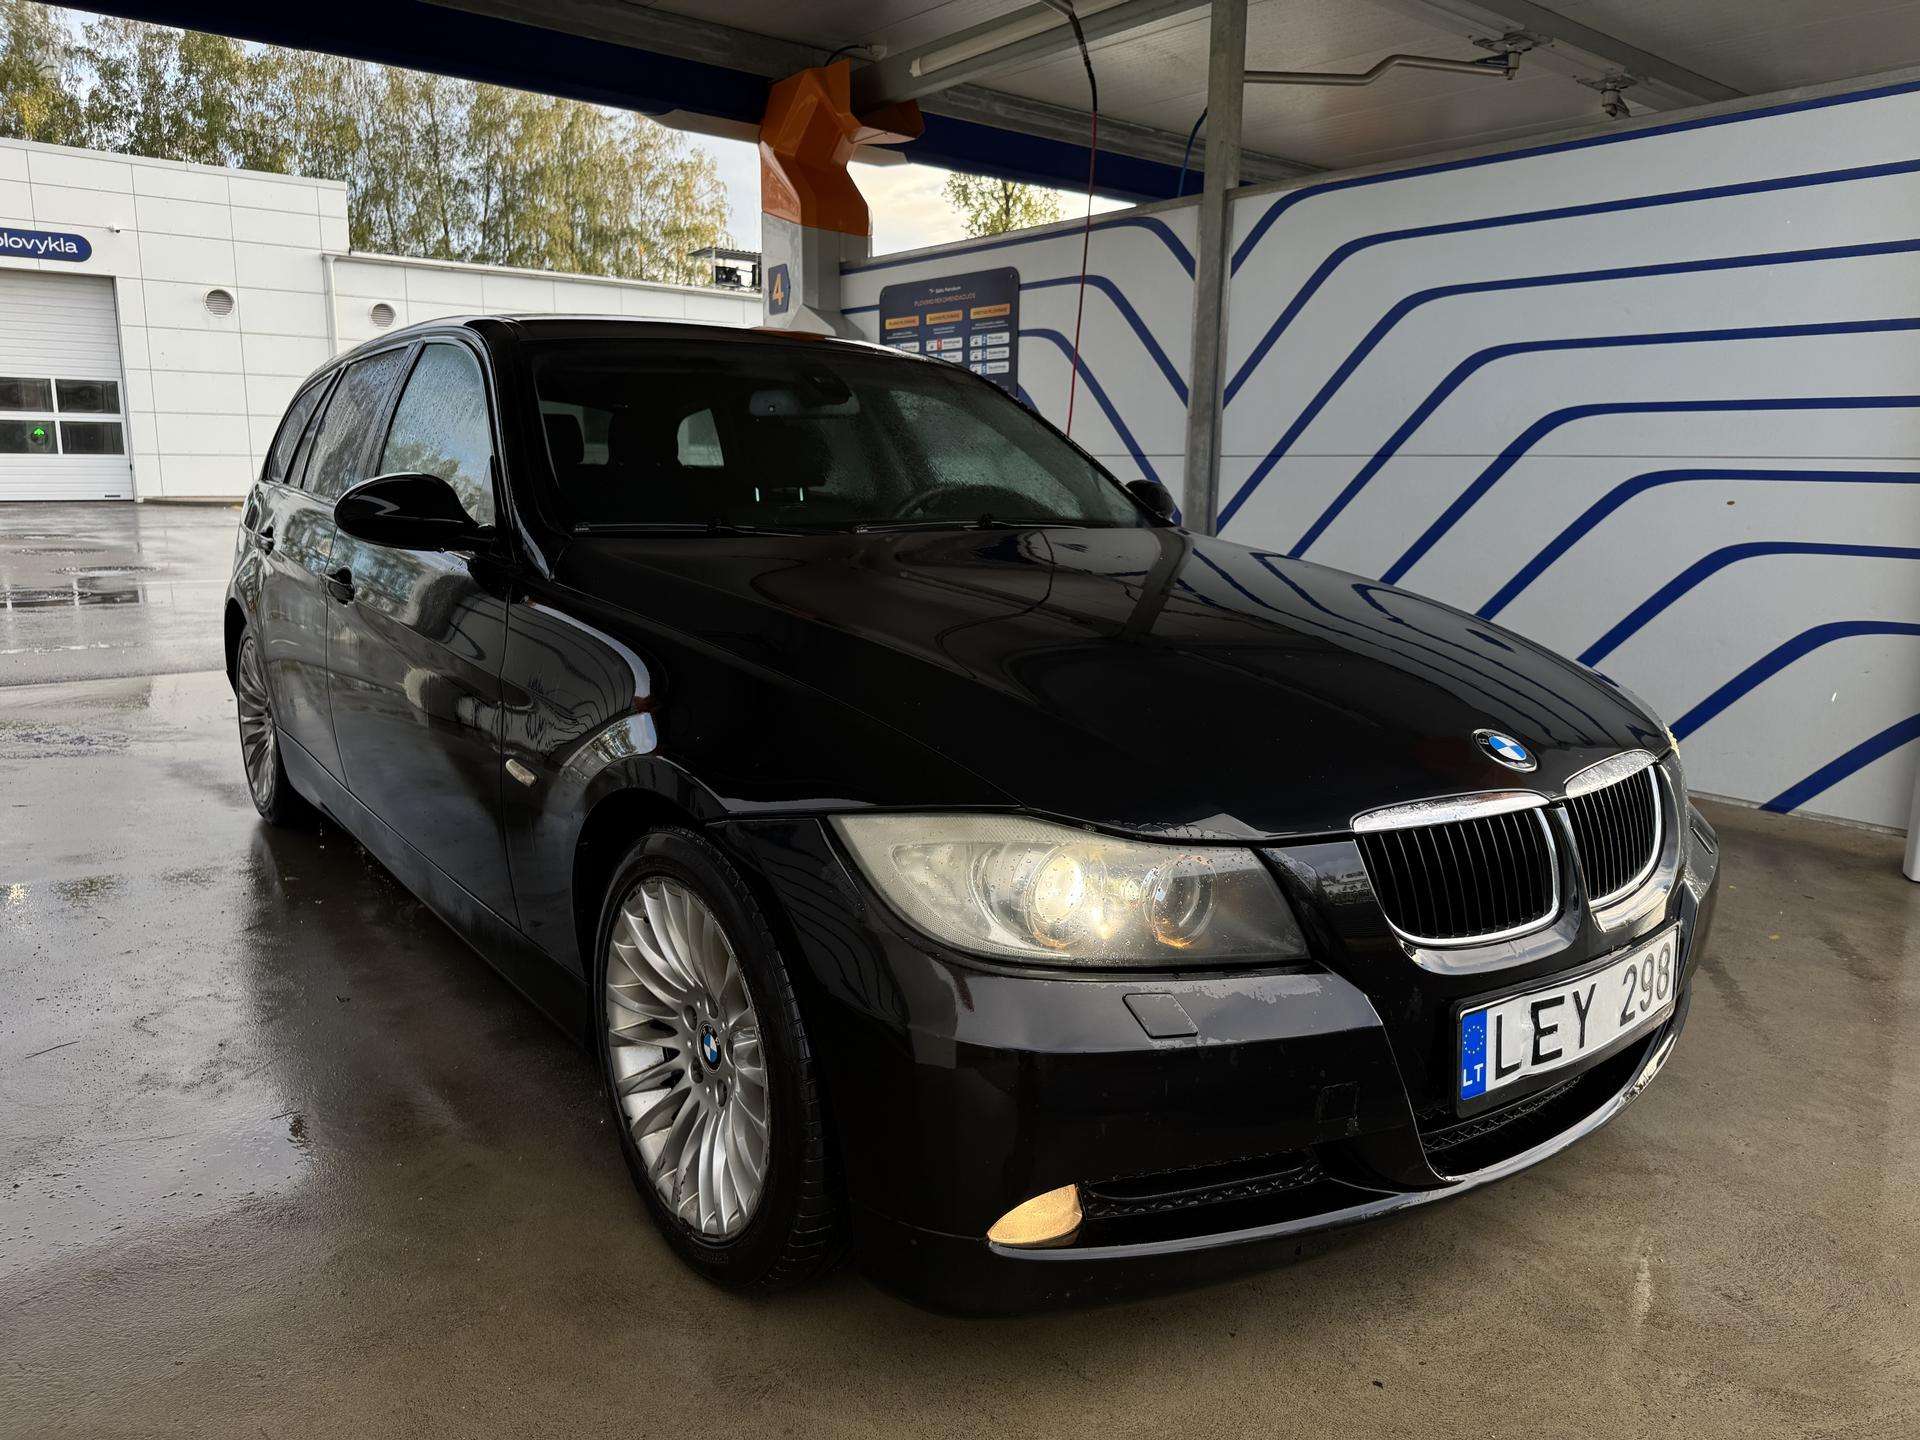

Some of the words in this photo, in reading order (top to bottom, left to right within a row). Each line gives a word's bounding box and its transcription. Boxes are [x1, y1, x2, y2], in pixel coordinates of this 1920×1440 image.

[773, 273, 785, 305] 4
[1495, 983, 1597, 1081] LEY
[1619, 942, 1671, 1027] 298
[1462, 1063, 1484, 1087] LT
